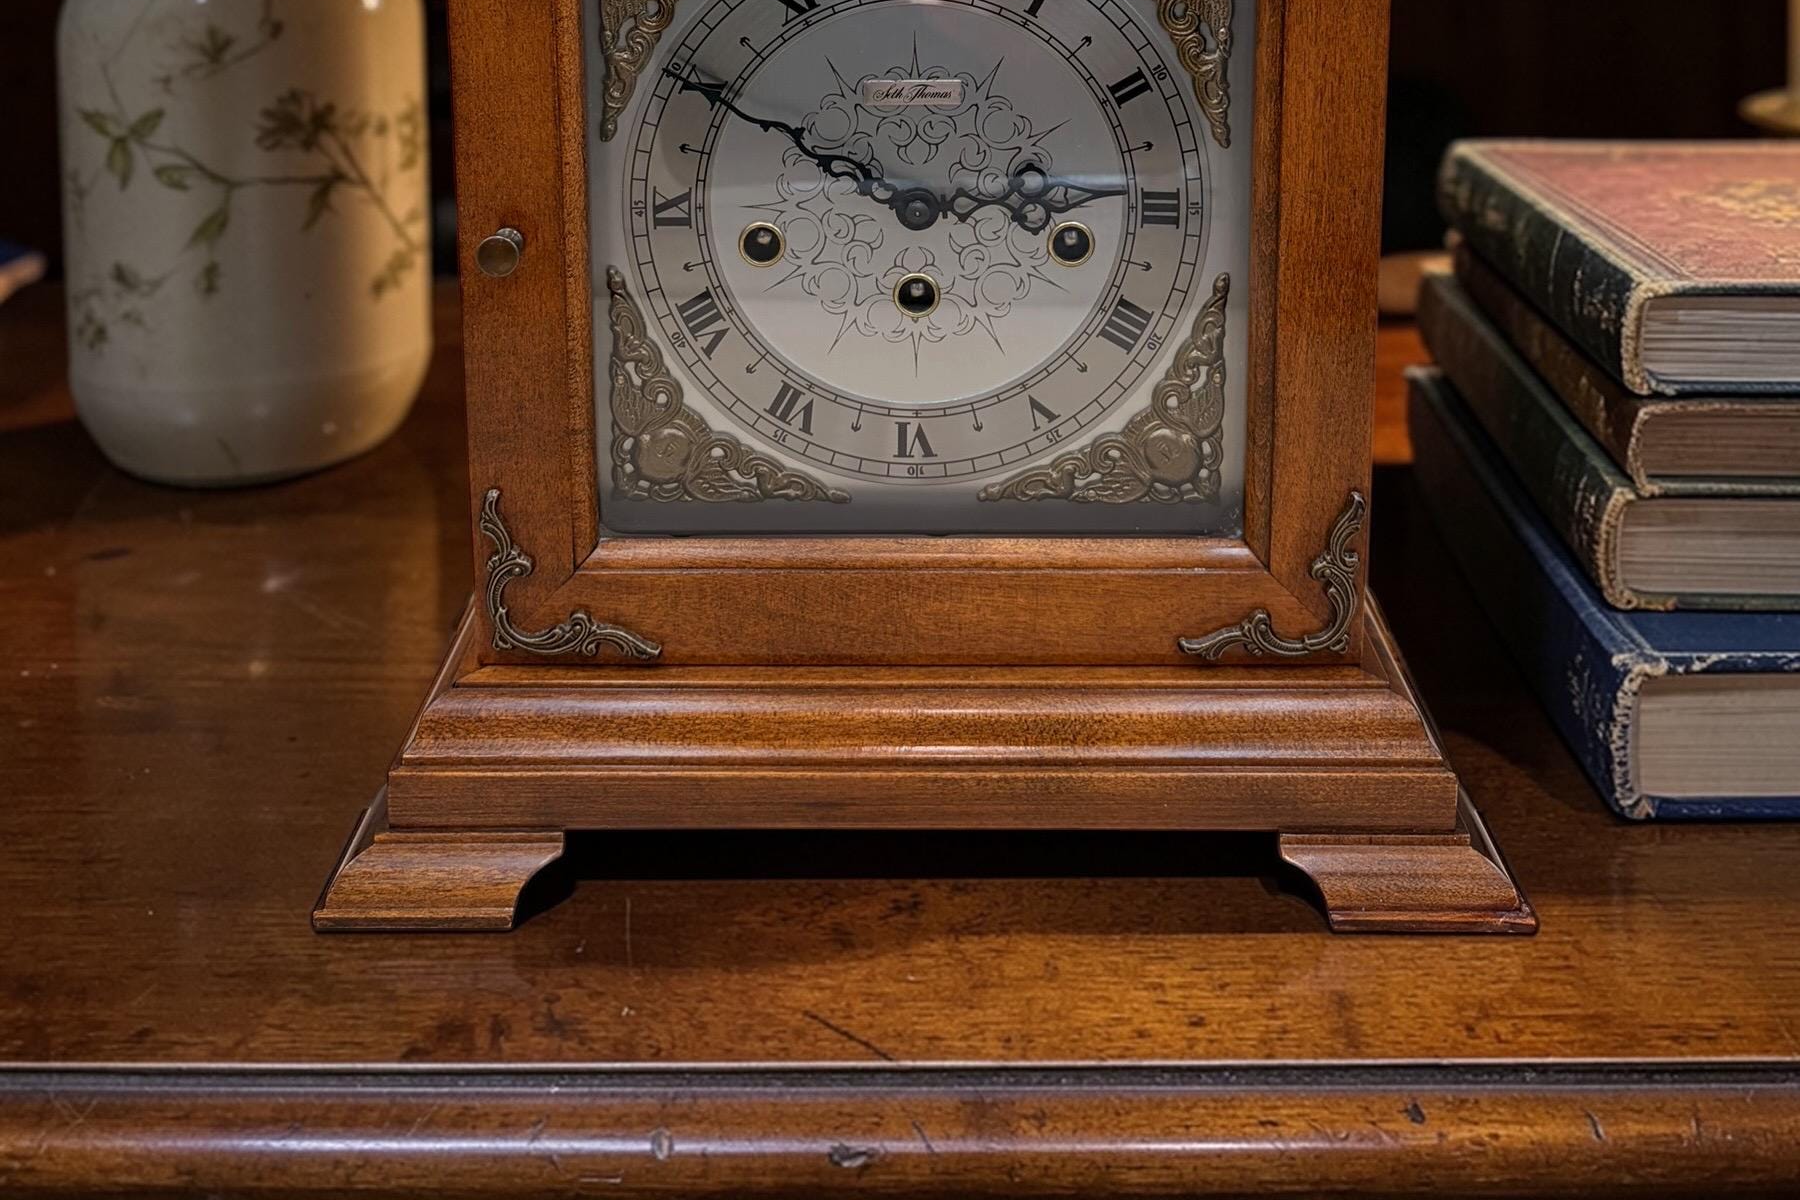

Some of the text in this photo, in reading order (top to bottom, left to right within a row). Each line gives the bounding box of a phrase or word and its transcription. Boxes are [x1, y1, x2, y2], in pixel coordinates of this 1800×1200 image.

[1106, 66, 1154, 110] II
[1152, 64, 1167, 81] 10
[873, 83, 952, 104] Seth Thomas
[633, 200, 645, 218] 45
[653, 185, 693, 230] IX
[1140, 187, 1180, 230] III
[1190, 201, 1200, 217] 15
[671, 331, 686, 349] 40
[674, 285, 730, 361] VIII
[1096, 294, 1155, 356] IIII
[1147, 332, 1163, 351] 20
[763, 379, 814, 437] VII
[1028, 394, 1062, 432] V
[893, 421, 938, 458] VI
[1046, 428, 1063, 444] 25
